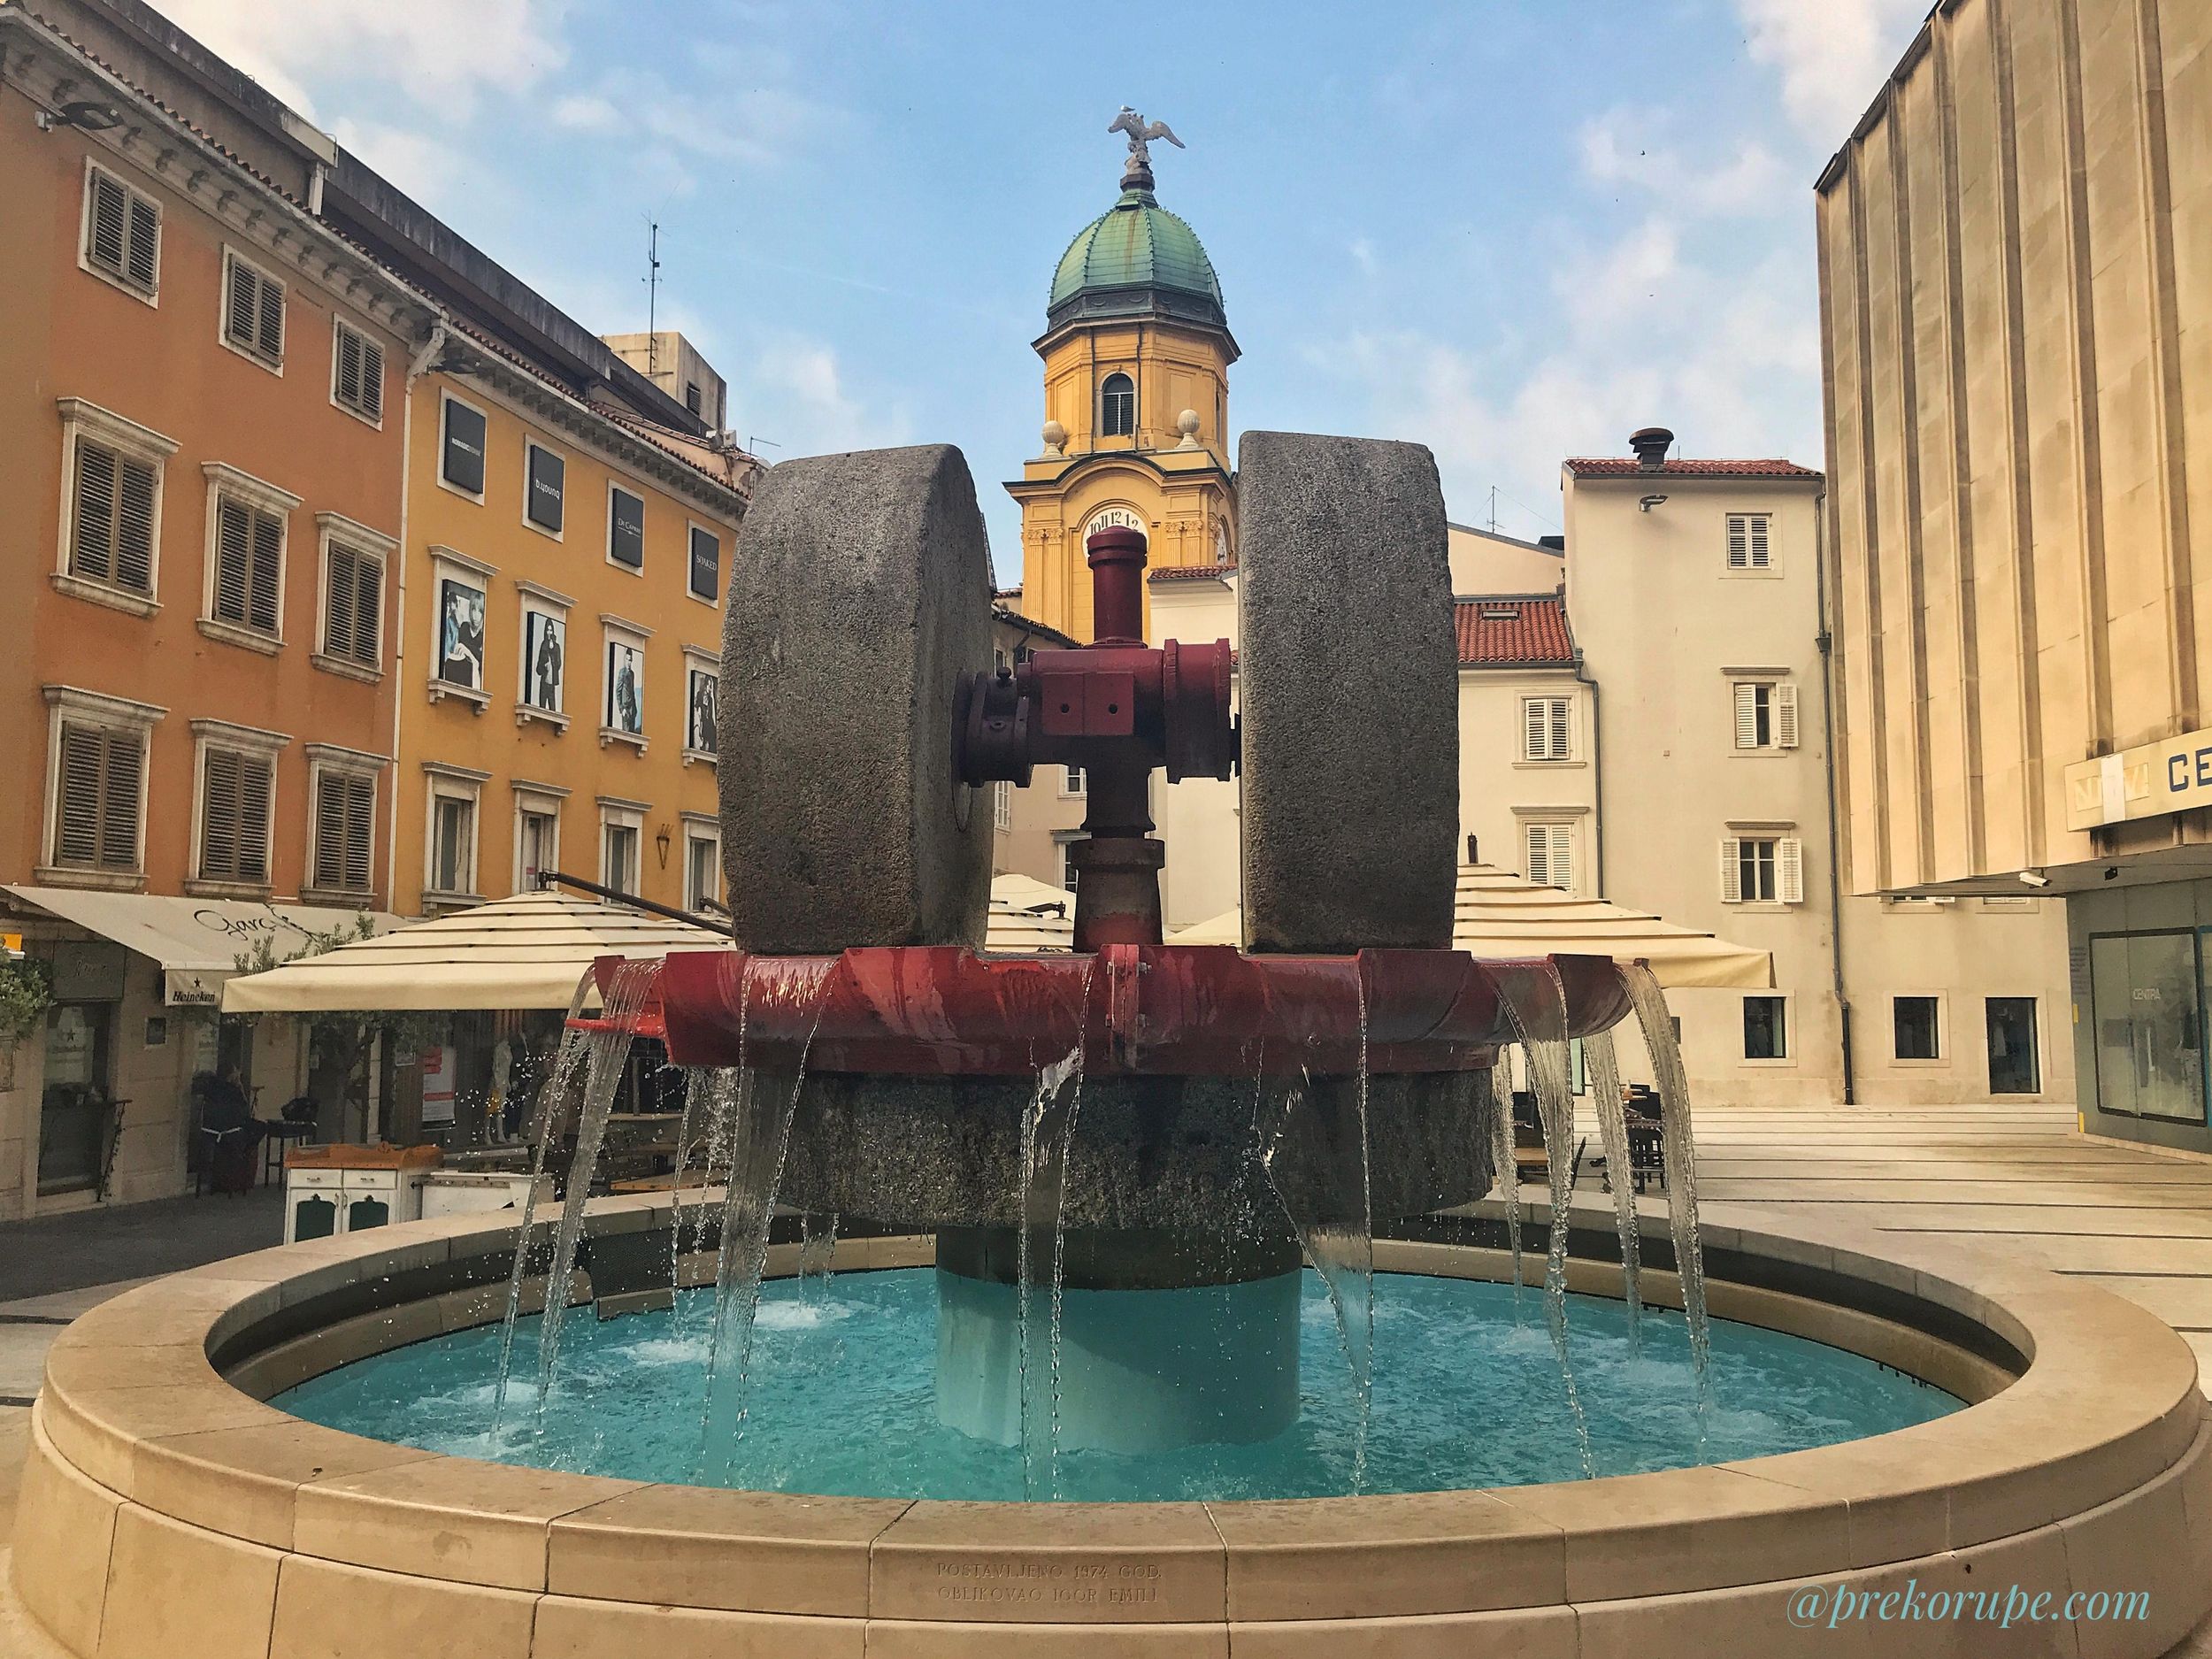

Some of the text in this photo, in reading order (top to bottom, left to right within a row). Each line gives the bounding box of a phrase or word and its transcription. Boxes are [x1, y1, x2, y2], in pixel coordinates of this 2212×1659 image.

[1110, 511, 1122, 525] 12
[1132, 519, 1139, 532] 2
[695, 554, 717, 572] SOAKED
[173, 990, 216, 1002] Heineken
[938, 1563, 1063, 1579] POSTAVLJENO
[1074, 1564, 1108, 1579] 1974
[938, 1586, 1159, 1602] OBLIKOVAO IGOR EMILI
